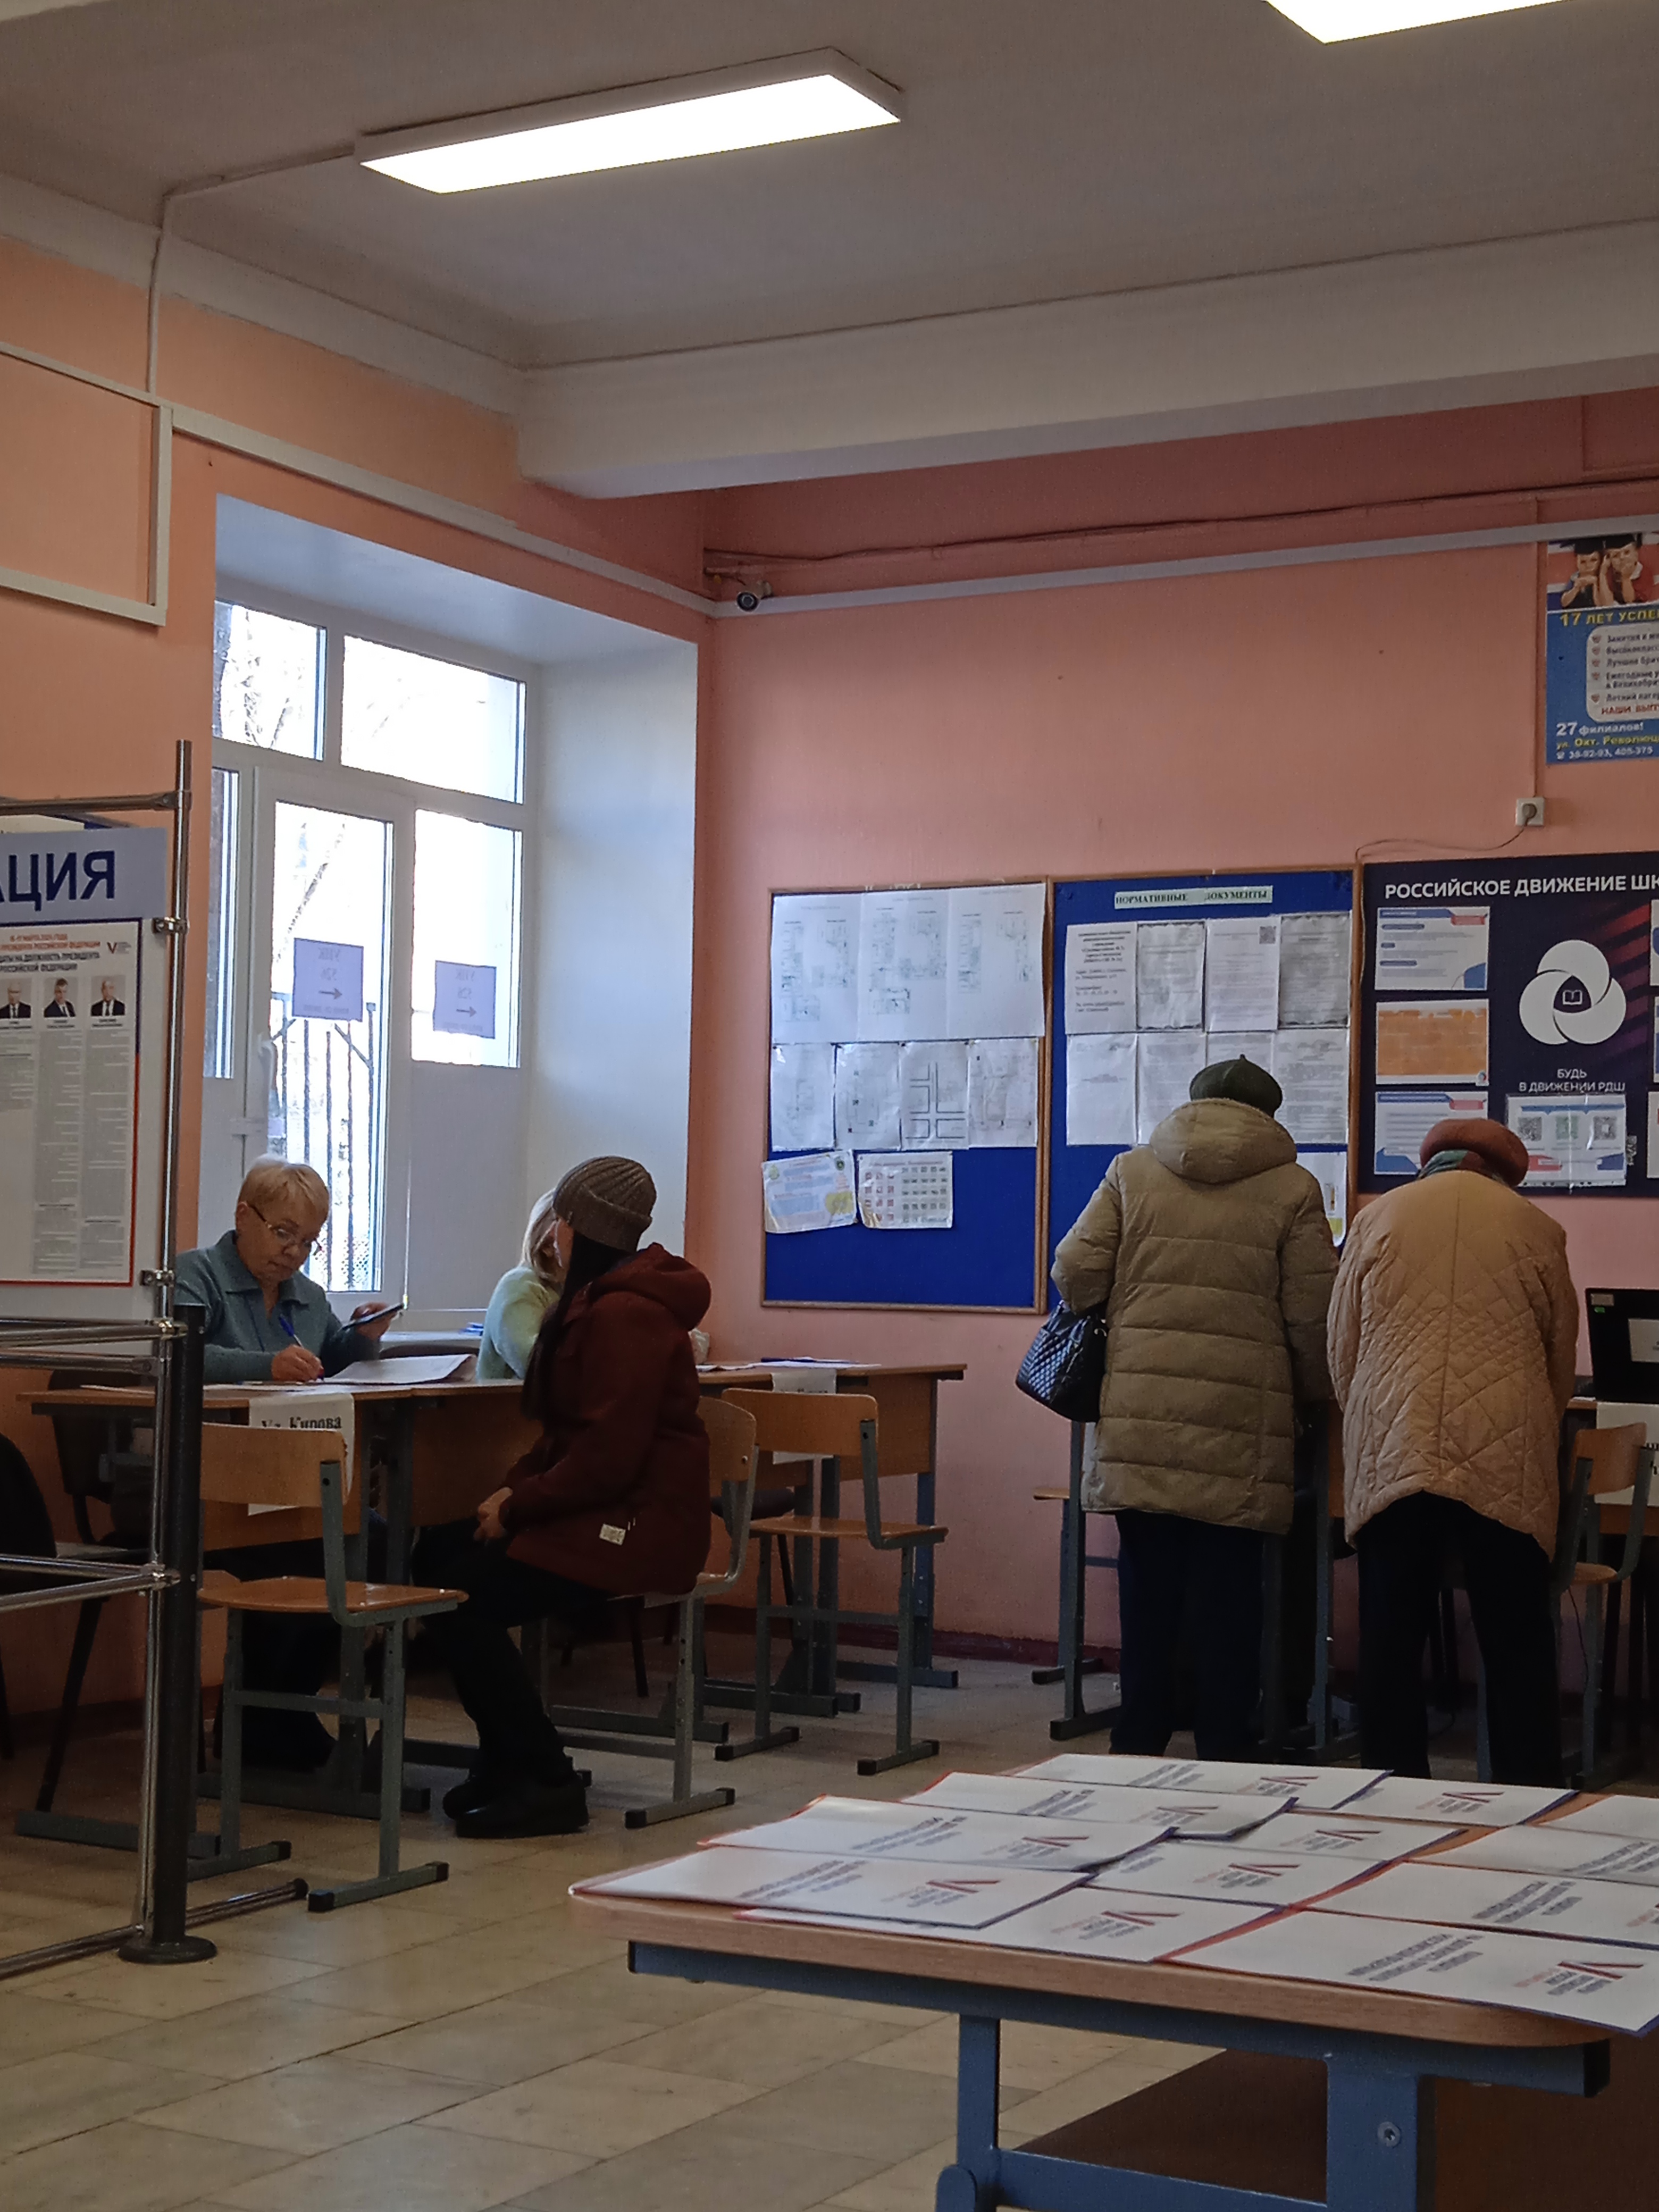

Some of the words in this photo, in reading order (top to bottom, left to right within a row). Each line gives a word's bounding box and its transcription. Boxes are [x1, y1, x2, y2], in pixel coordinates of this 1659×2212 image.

[1560, 611, 1581, 626] 17
[1585, 612, 1614, 624] ЛЕТ
[1619, 609, 1659, 622] УСПЕ
[1601, 706, 1631, 715] НАШИ
[1556, 722, 1578, 736] 27
[1579, 722, 1644, 737] филиалов!
[0, 850, 115, 912] ЦИЯ
[1385, 878, 1511, 899] РОССИЙСКОЕ
[1514, 875, 1627, 897] ДВИЖЕНИЕ
[1631, 874, 1659, 891] ШК
[1116, 893, 1188, 904] НОРМАТИВНЫЕ
[1204, 891, 1268, 901] ДОКУМЕНТЫ
[1557, 1068, 1588, 1079] БУДЬ
[1519, 1082, 1527, 1092] В
[1528, 1082, 1596, 1093] ДВИЖЕНИИ
[1598, 1082, 1626, 1092] РДШ
